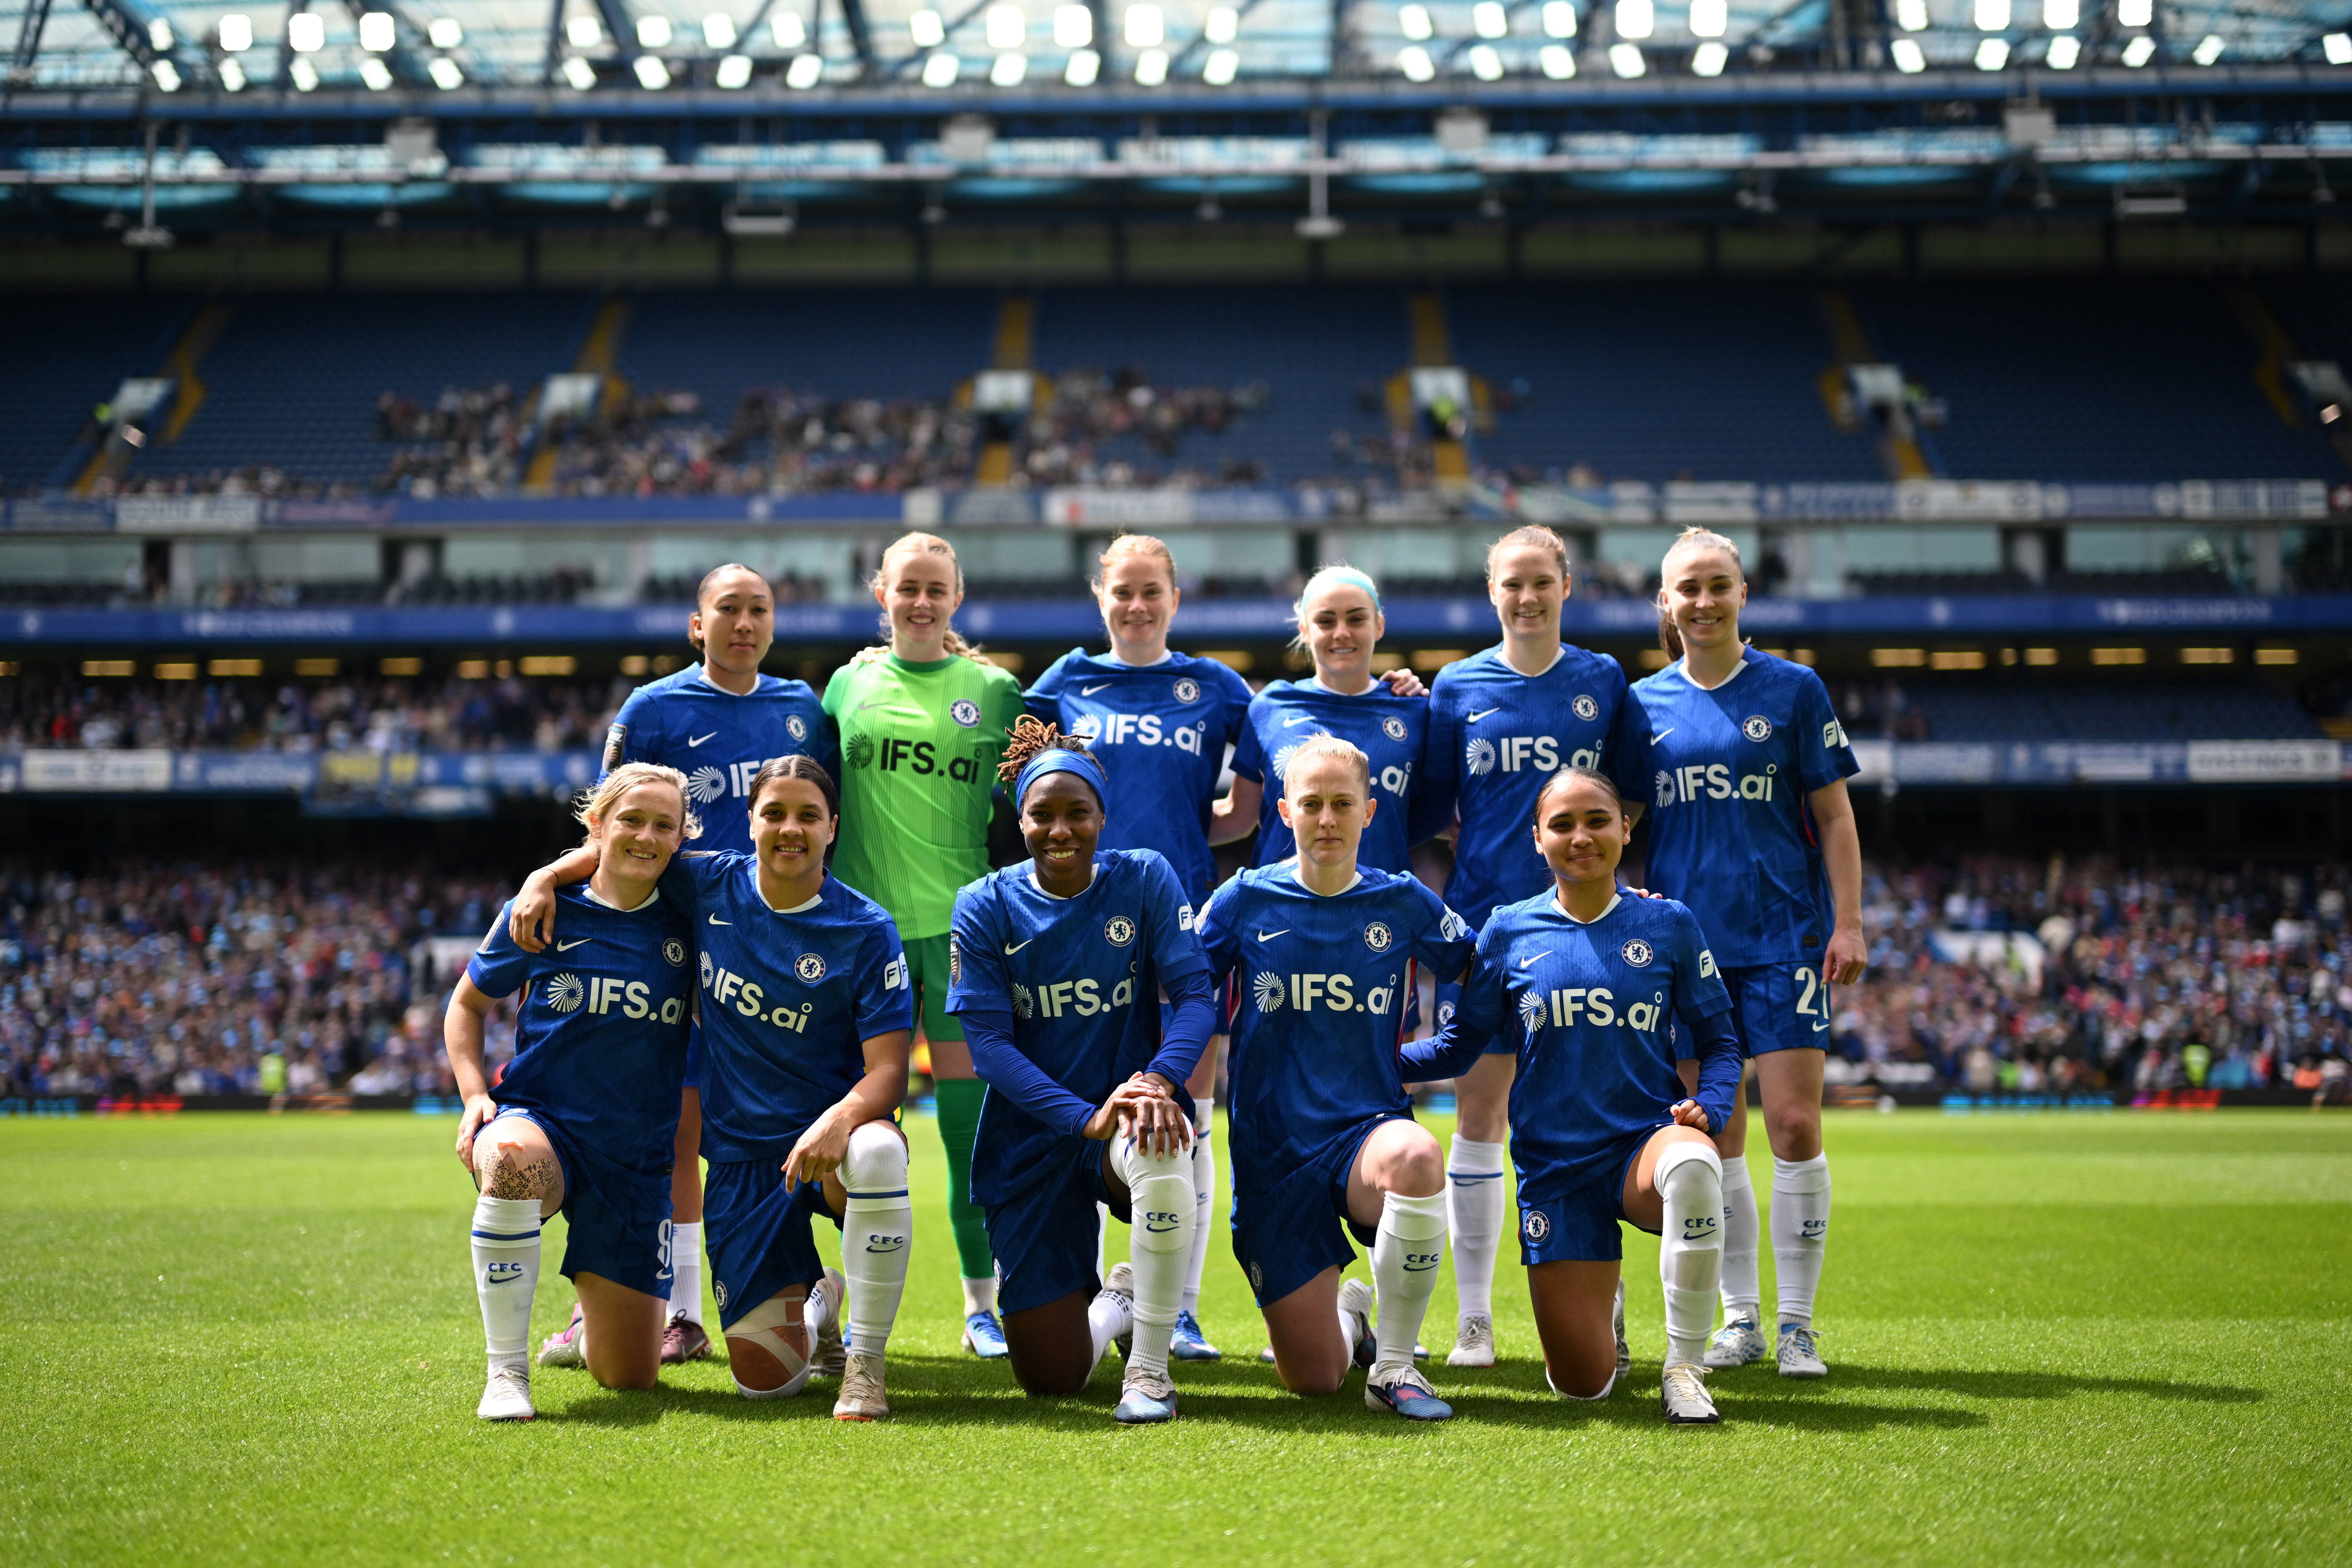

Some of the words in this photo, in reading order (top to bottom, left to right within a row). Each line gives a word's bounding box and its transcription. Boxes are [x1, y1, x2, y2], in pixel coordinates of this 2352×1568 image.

[1106, 714, 1205, 756] IFS.ai
[881, 738, 981, 784] IFS.ai
[1676, 764, 1776, 803] IFS.ai
[804, 955, 823, 964] CHELSEA
[589, 977, 687, 1025] IFS.ai
[714, 967, 812, 1033] IFS.ai
[1291, 974, 1396, 1015] IFS.ai
[1551, 988, 1662, 1032] IFS.ai
[1795, 967, 1829, 1019] 21
[1146, 1212, 1179, 1223] CFC
[1684, 1217, 1715, 1228] CFC
[1803, 1219, 1826, 1228] CFC
[657, 1219, 672, 1268] 8
[870, 1234, 903, 1245] CFC
[1406, 1253, 1439, 1264] CFC
[488, 1262, 522, 1273] CFC
